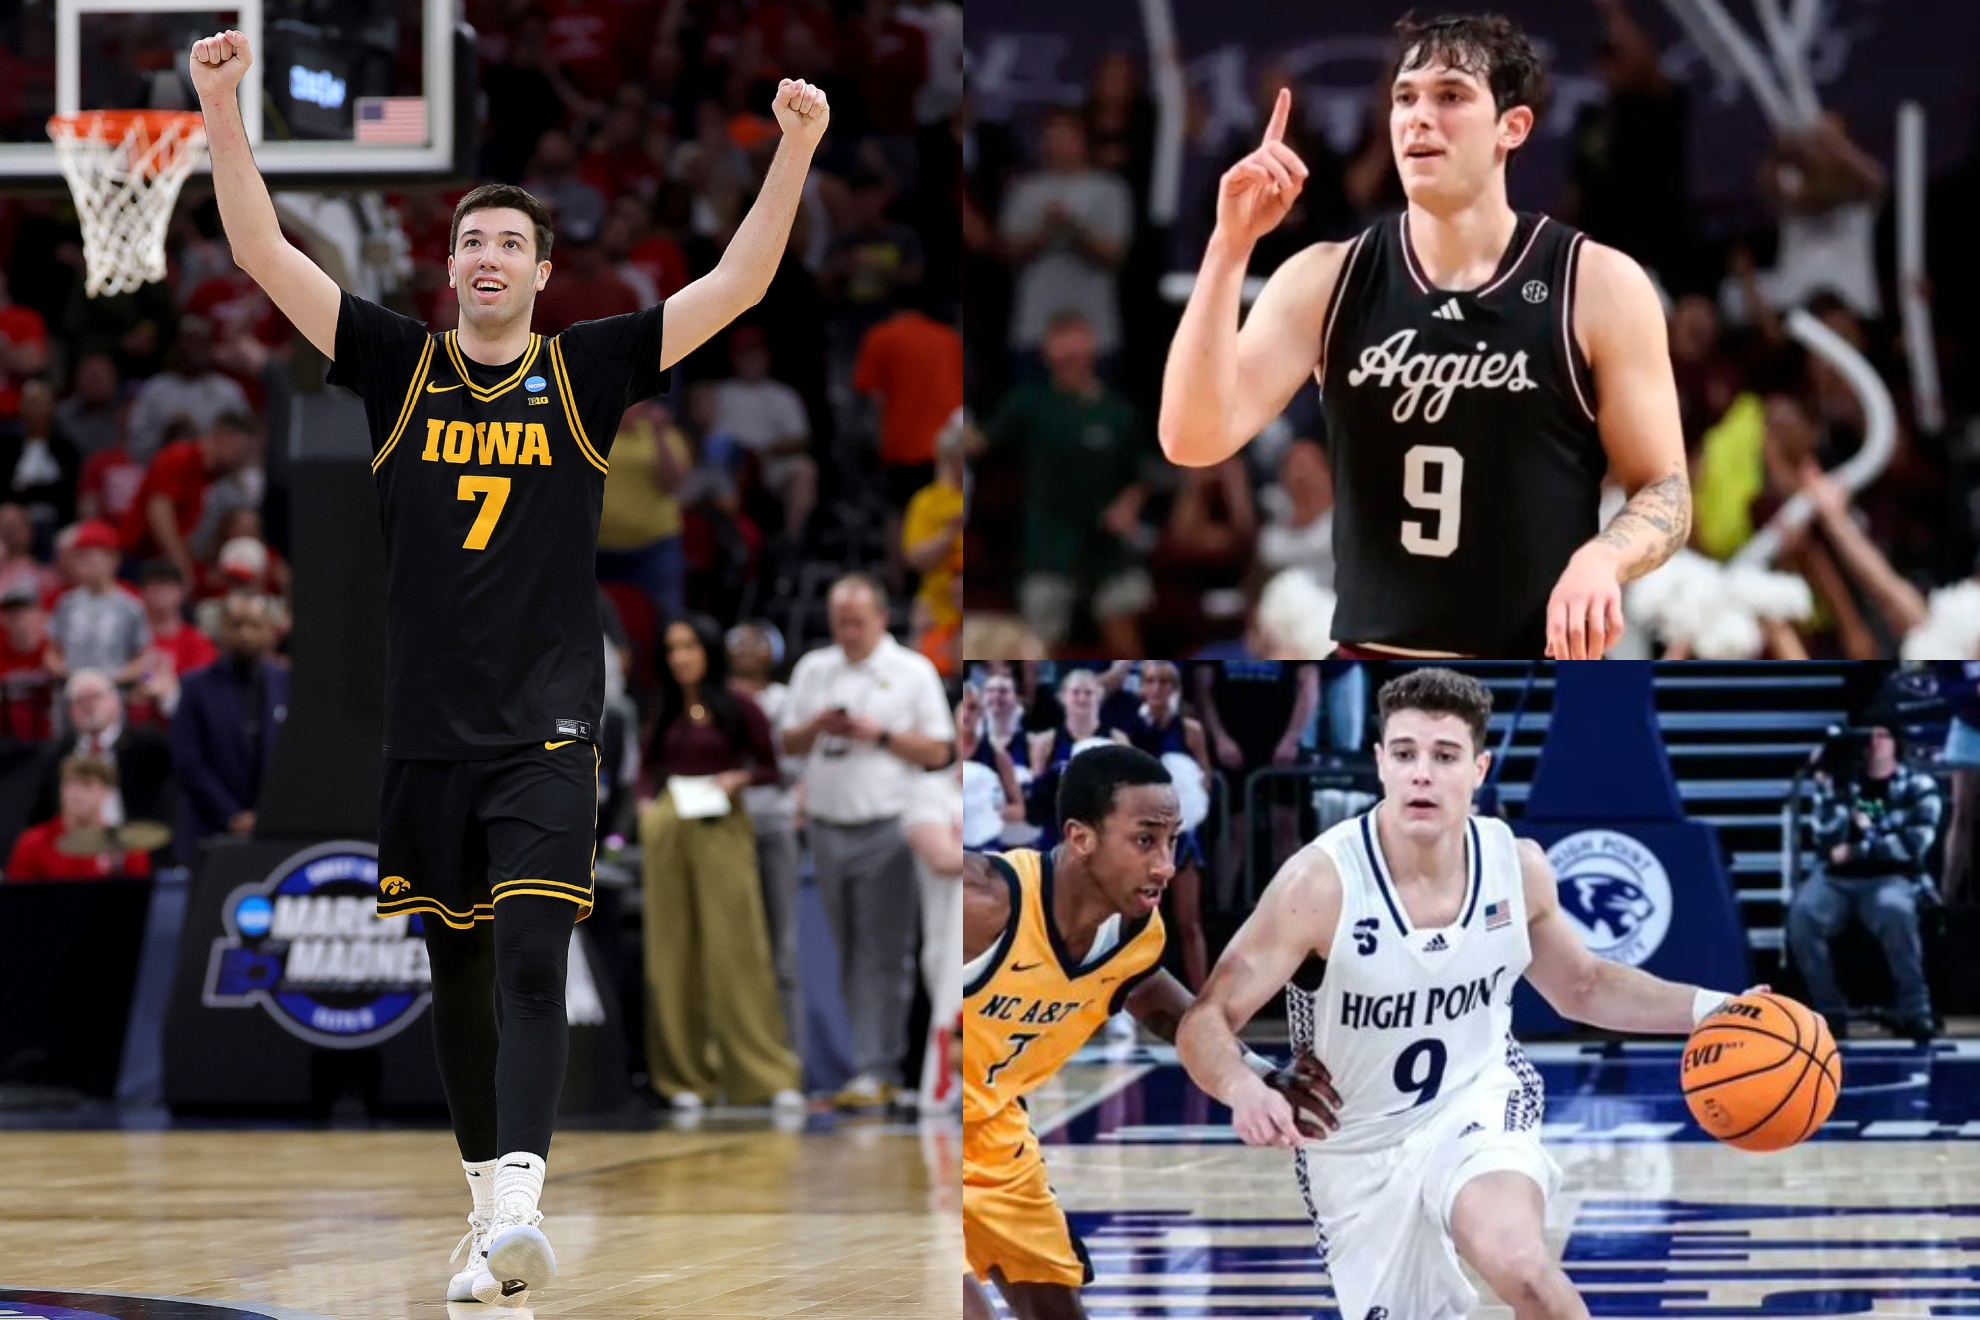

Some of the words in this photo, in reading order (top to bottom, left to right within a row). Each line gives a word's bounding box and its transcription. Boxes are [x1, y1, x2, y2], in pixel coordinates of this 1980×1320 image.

[1348, 328, 1539, 423] Aggies
[421, 418, 553, 466] IOWA
[457, 475, 512, 550] 7
[1401, 444, 1465, 558] 9
[284, 938, 432, 983] MADNE
[979, 994, 1022, 1021] NC
[1340, 990, 1417, 1030] HIGH
[1424, 965, 1507, 1026] POINT
[1392, 1037, 1448, 1109] 9
